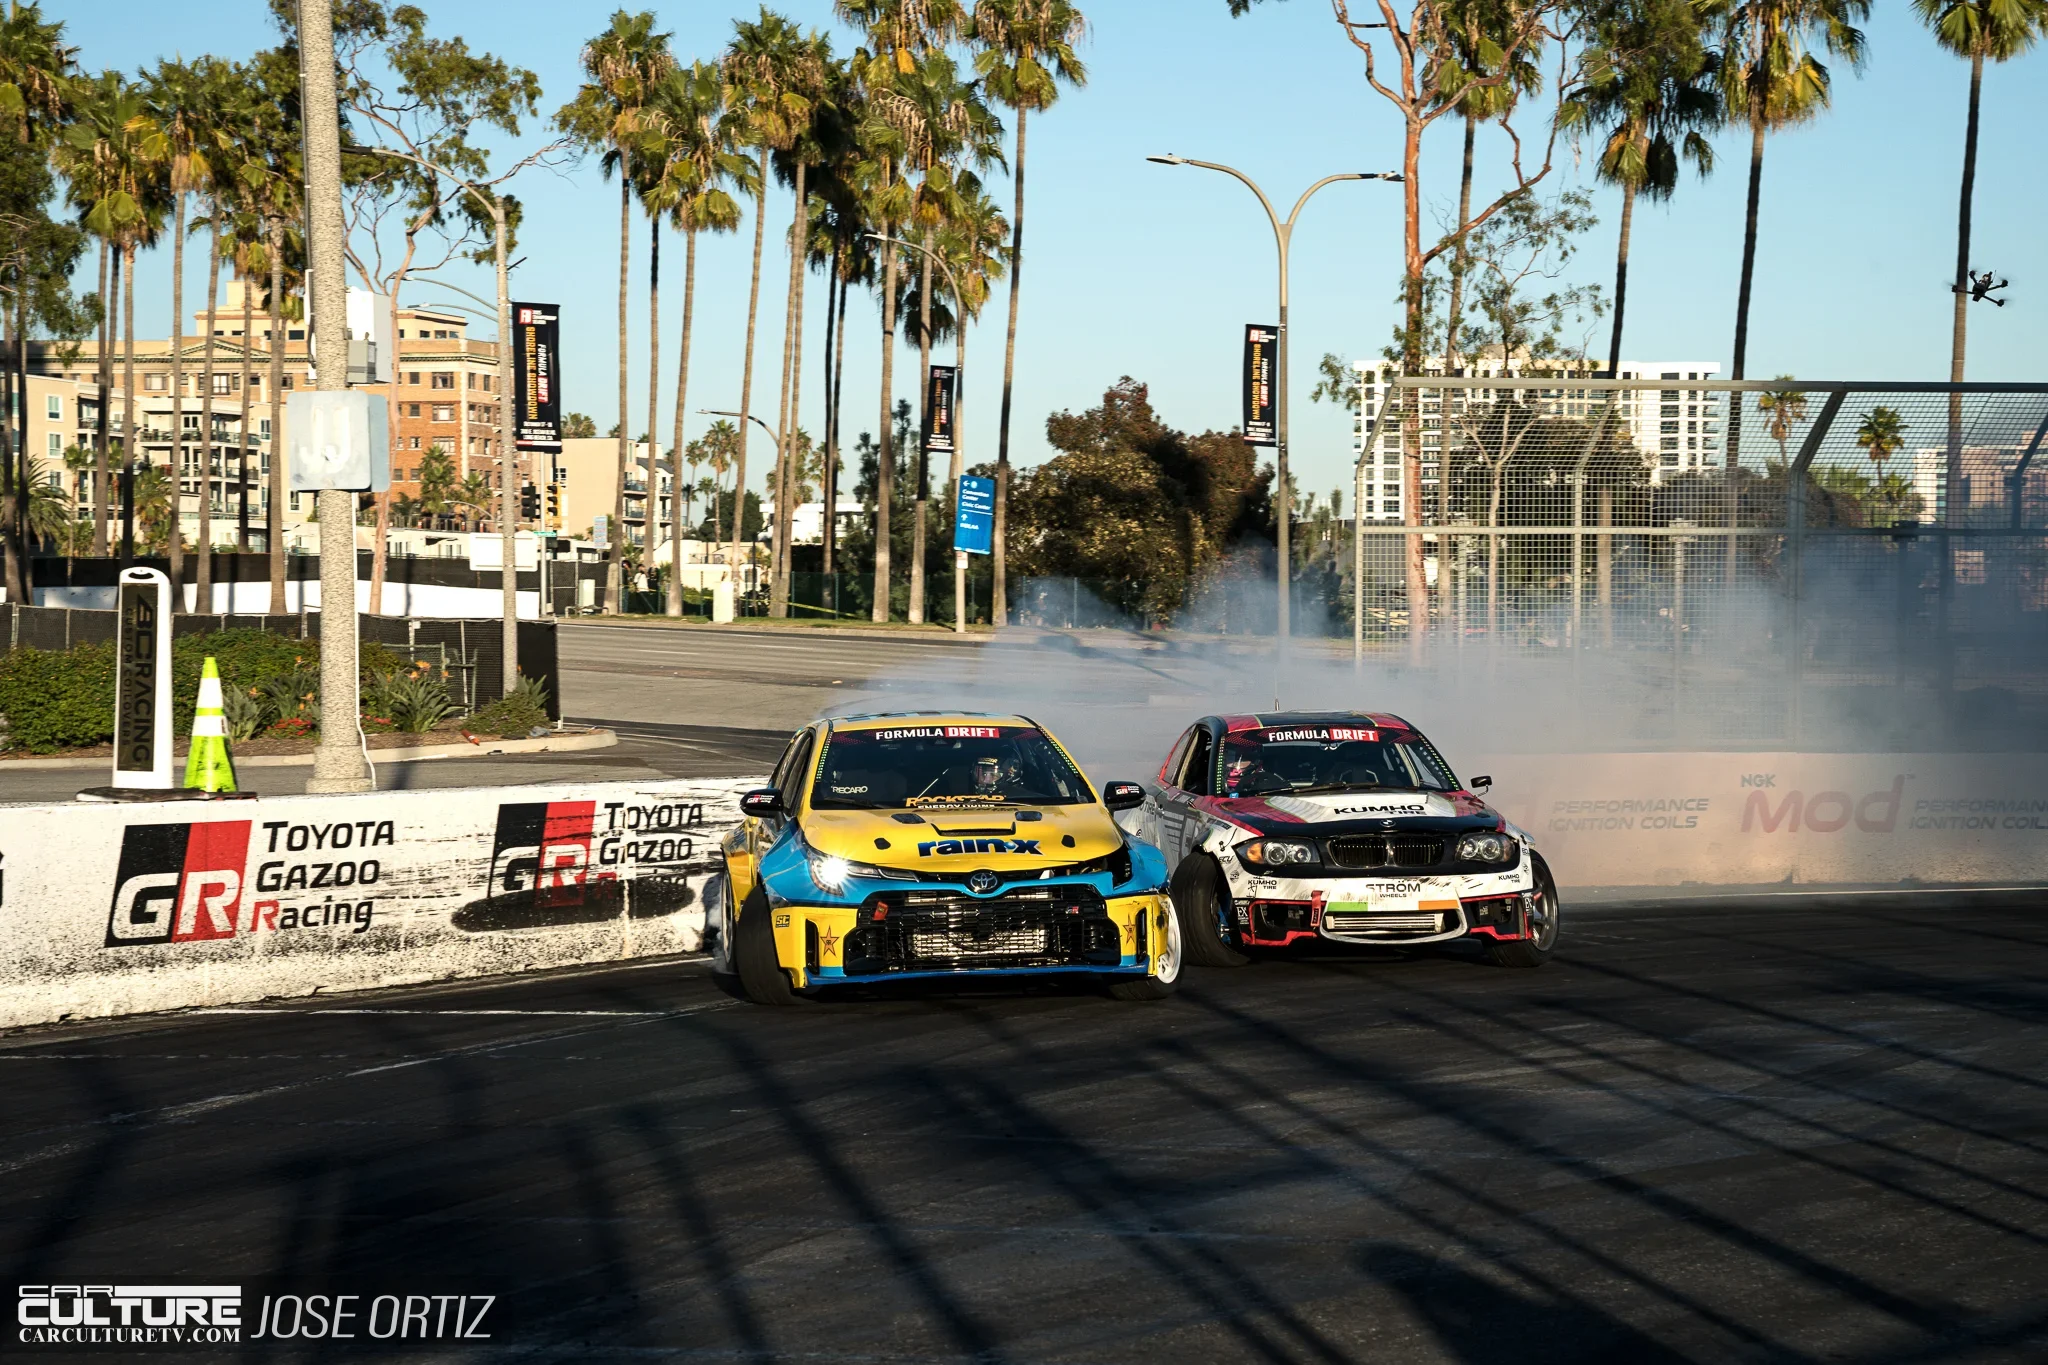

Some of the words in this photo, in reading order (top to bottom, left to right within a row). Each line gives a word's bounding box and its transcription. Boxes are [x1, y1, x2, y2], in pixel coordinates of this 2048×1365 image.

[526, 327, 536, 370] SHORELINE
[527, 373, 538, 419] SHOWDOWN
[538, 377, 548, 403] DRIFT
[124, 607, 133, 664] CUSTOM
[876, 728, 944, 740] FORMULA
[948, 728, 995, 738] DRIFT
[1269, 730, 1329, 741] FORMULA
[1333, 729, 1375, 740] DRIFT
[832, 786, 868, 794] RECARO
[1741, 774, 1776, 788] NGK
[604, 802, 702, 830] TOYOTA
[1334, 805, 1425, 815] KUMHO
[1552, 798, 1709, 814] PERFORMANCE
[1549, 816, 1634, 831] IGNITION
[1640, 816, 1698, 829] COILS
[1909, 816, 1996, 830] IGNITION
[262, 820, 394, 853] TOYOTA
[600, 838, 692, 865] GAZOO
[257, 860, 379, 892] GAZOO
[1366, 880, 1421, 892] STRÖM
[111, 869, 240, 939] GR
[250, 896, 374, 934] Racing
